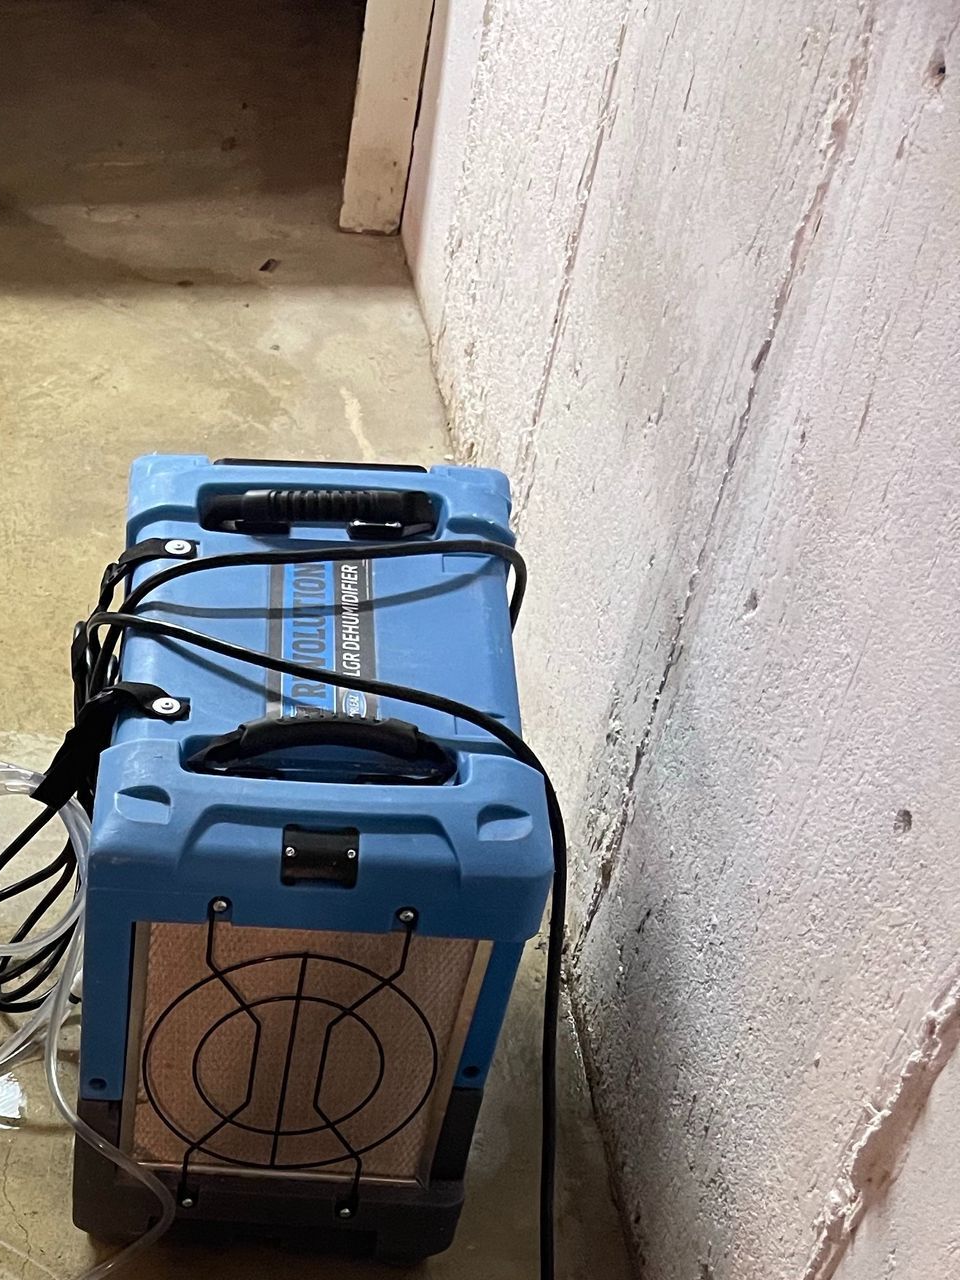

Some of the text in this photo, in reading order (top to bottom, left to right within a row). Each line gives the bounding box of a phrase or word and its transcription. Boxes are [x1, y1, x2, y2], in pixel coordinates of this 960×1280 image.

[291, 563, 326, 698] RVOLUTION
[341, 564, 361, 677] LGR DEHUMIDIFIER
